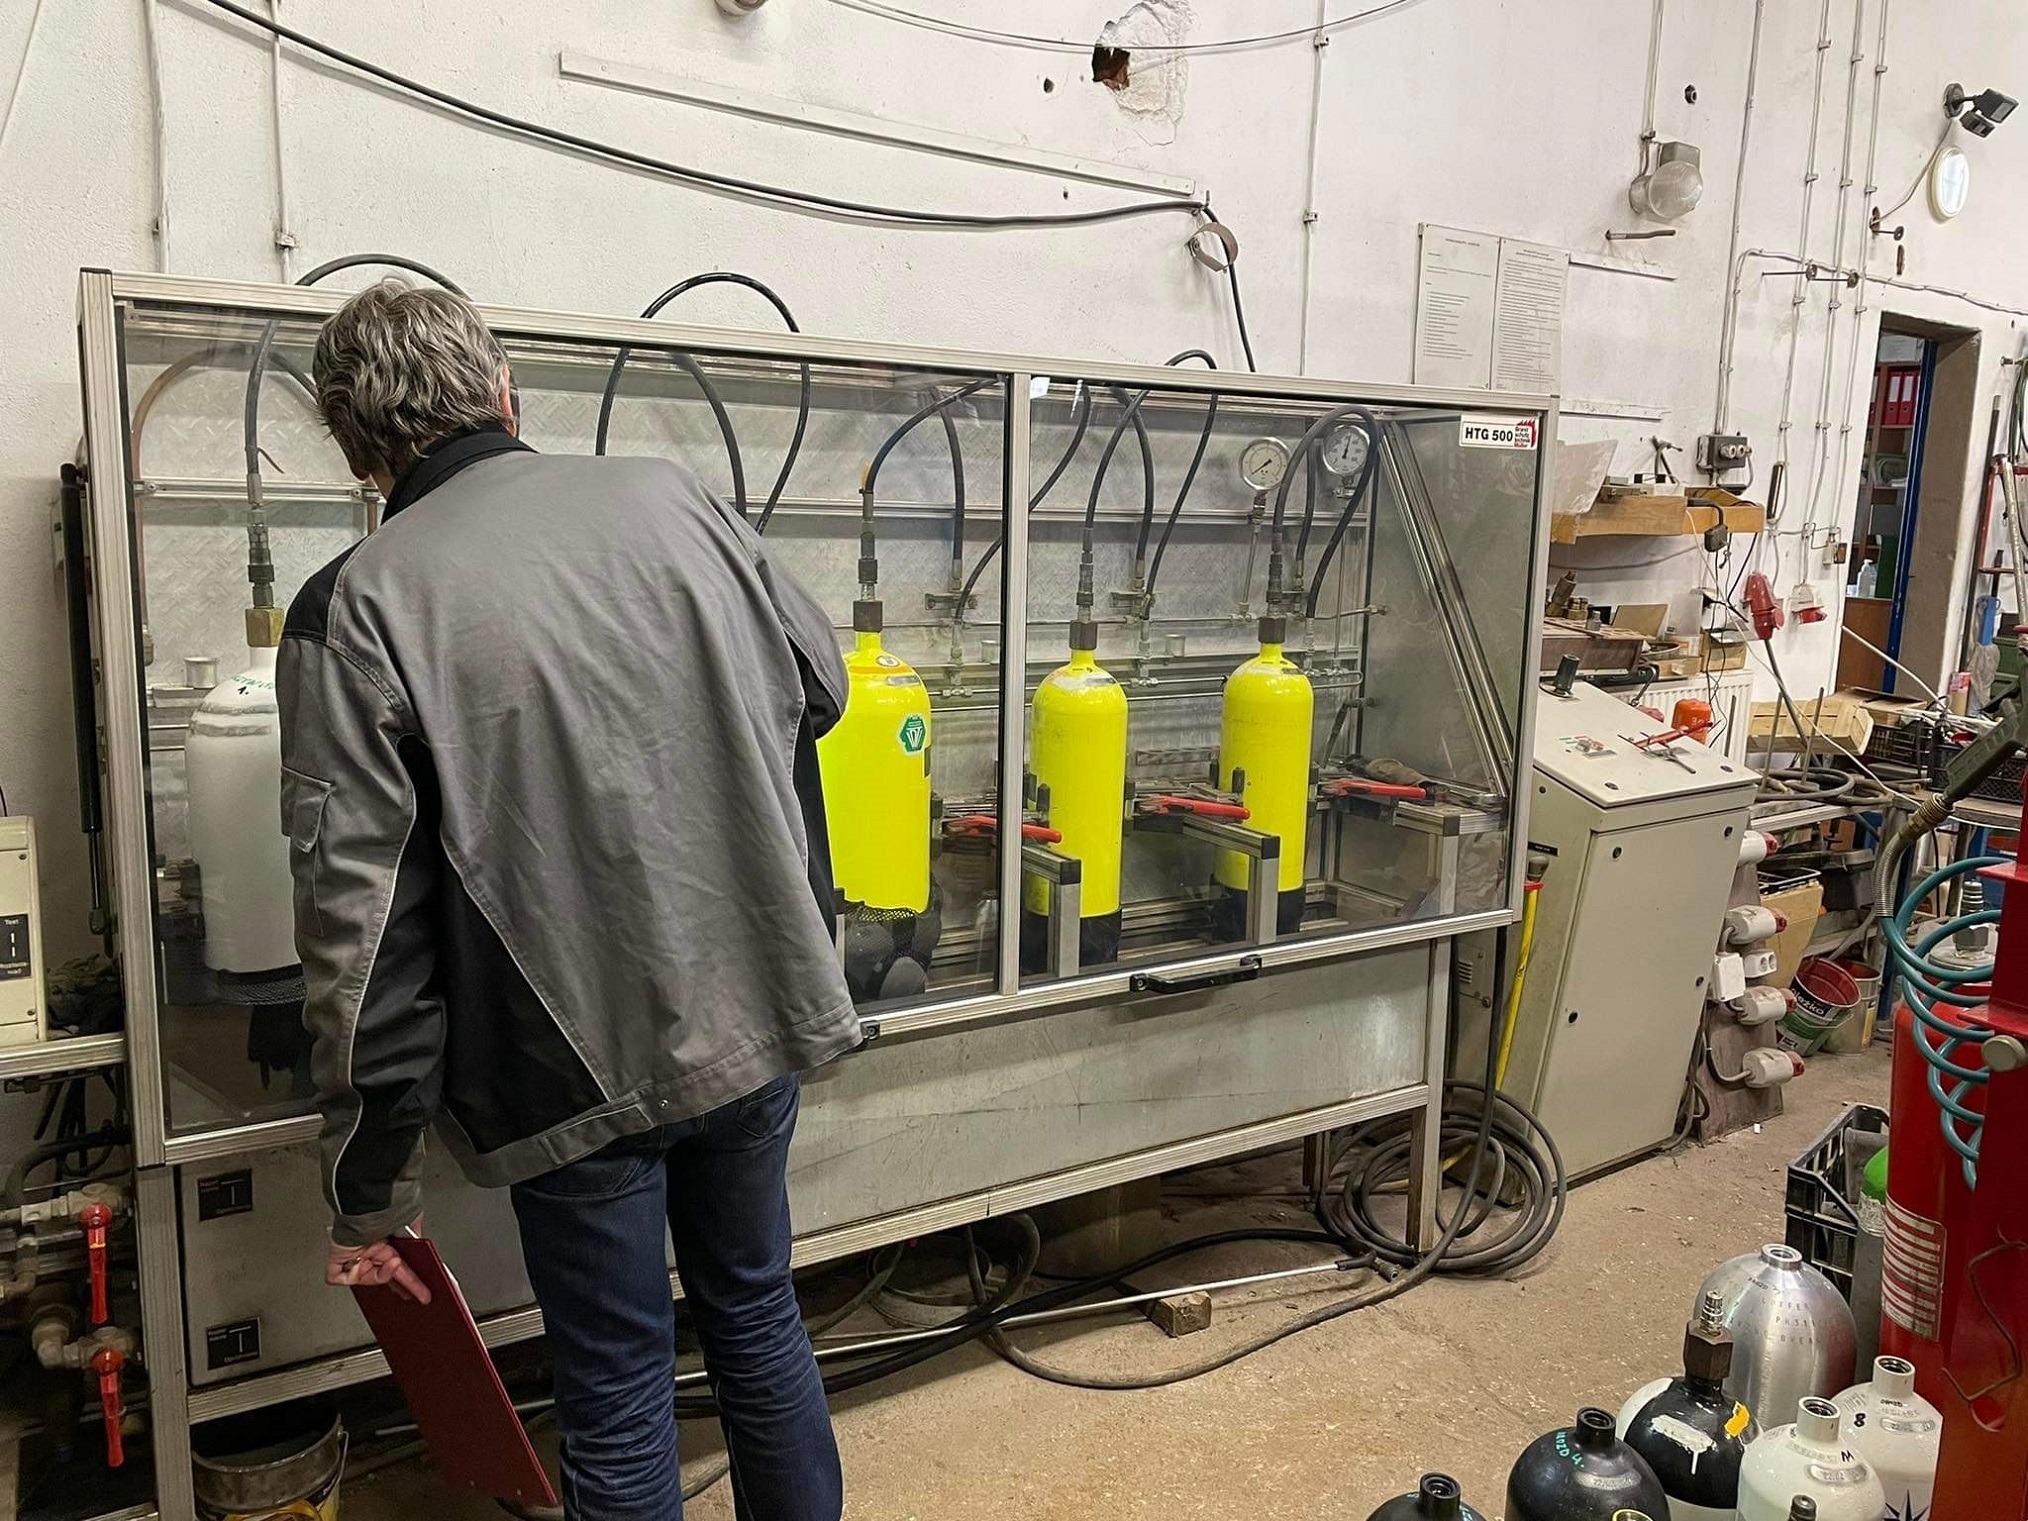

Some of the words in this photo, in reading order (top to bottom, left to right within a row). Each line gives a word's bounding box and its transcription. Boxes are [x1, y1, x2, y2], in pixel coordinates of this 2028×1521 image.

[1465, 427, 1489, 440] HTG
[1492, 430, 1513, 442] 500
[1854, 1413, 1866, 1427] 8
